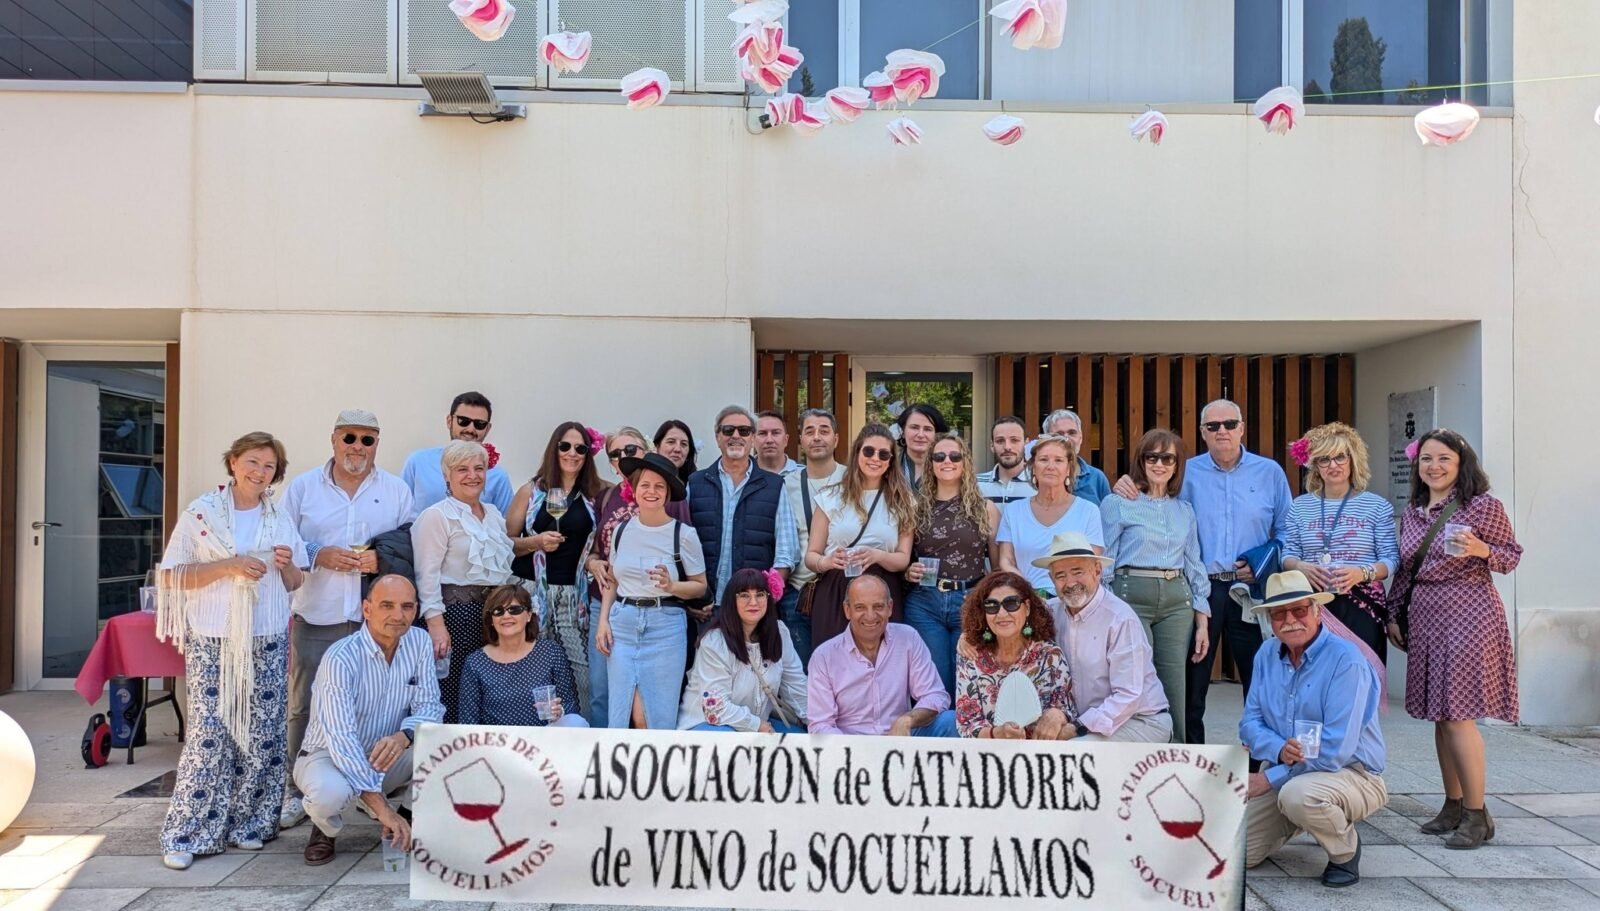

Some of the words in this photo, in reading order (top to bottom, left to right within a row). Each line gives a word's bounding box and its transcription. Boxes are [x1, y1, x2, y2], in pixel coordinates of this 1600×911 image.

[512, 738, 540, 761] DE
[538, 758, 565, 808] VINO
[577, 733, 823, 804] ASOCIACIÓN
[833, 747, 871, 806] de
[882, 749, 1101, 812] CATADORES
[1118, 748, 1190, 821] CATADORES
[1195, 754, 1221, 777] DE
[411, 838, 555, 890] SOCUELLAMOS
[590, 826, 631, 888] de
[644, 828, 747, 891] VINO
[757, 829, 797, 893] de
[806, 816, 1096, 899] SOCUÉLLAMOS
